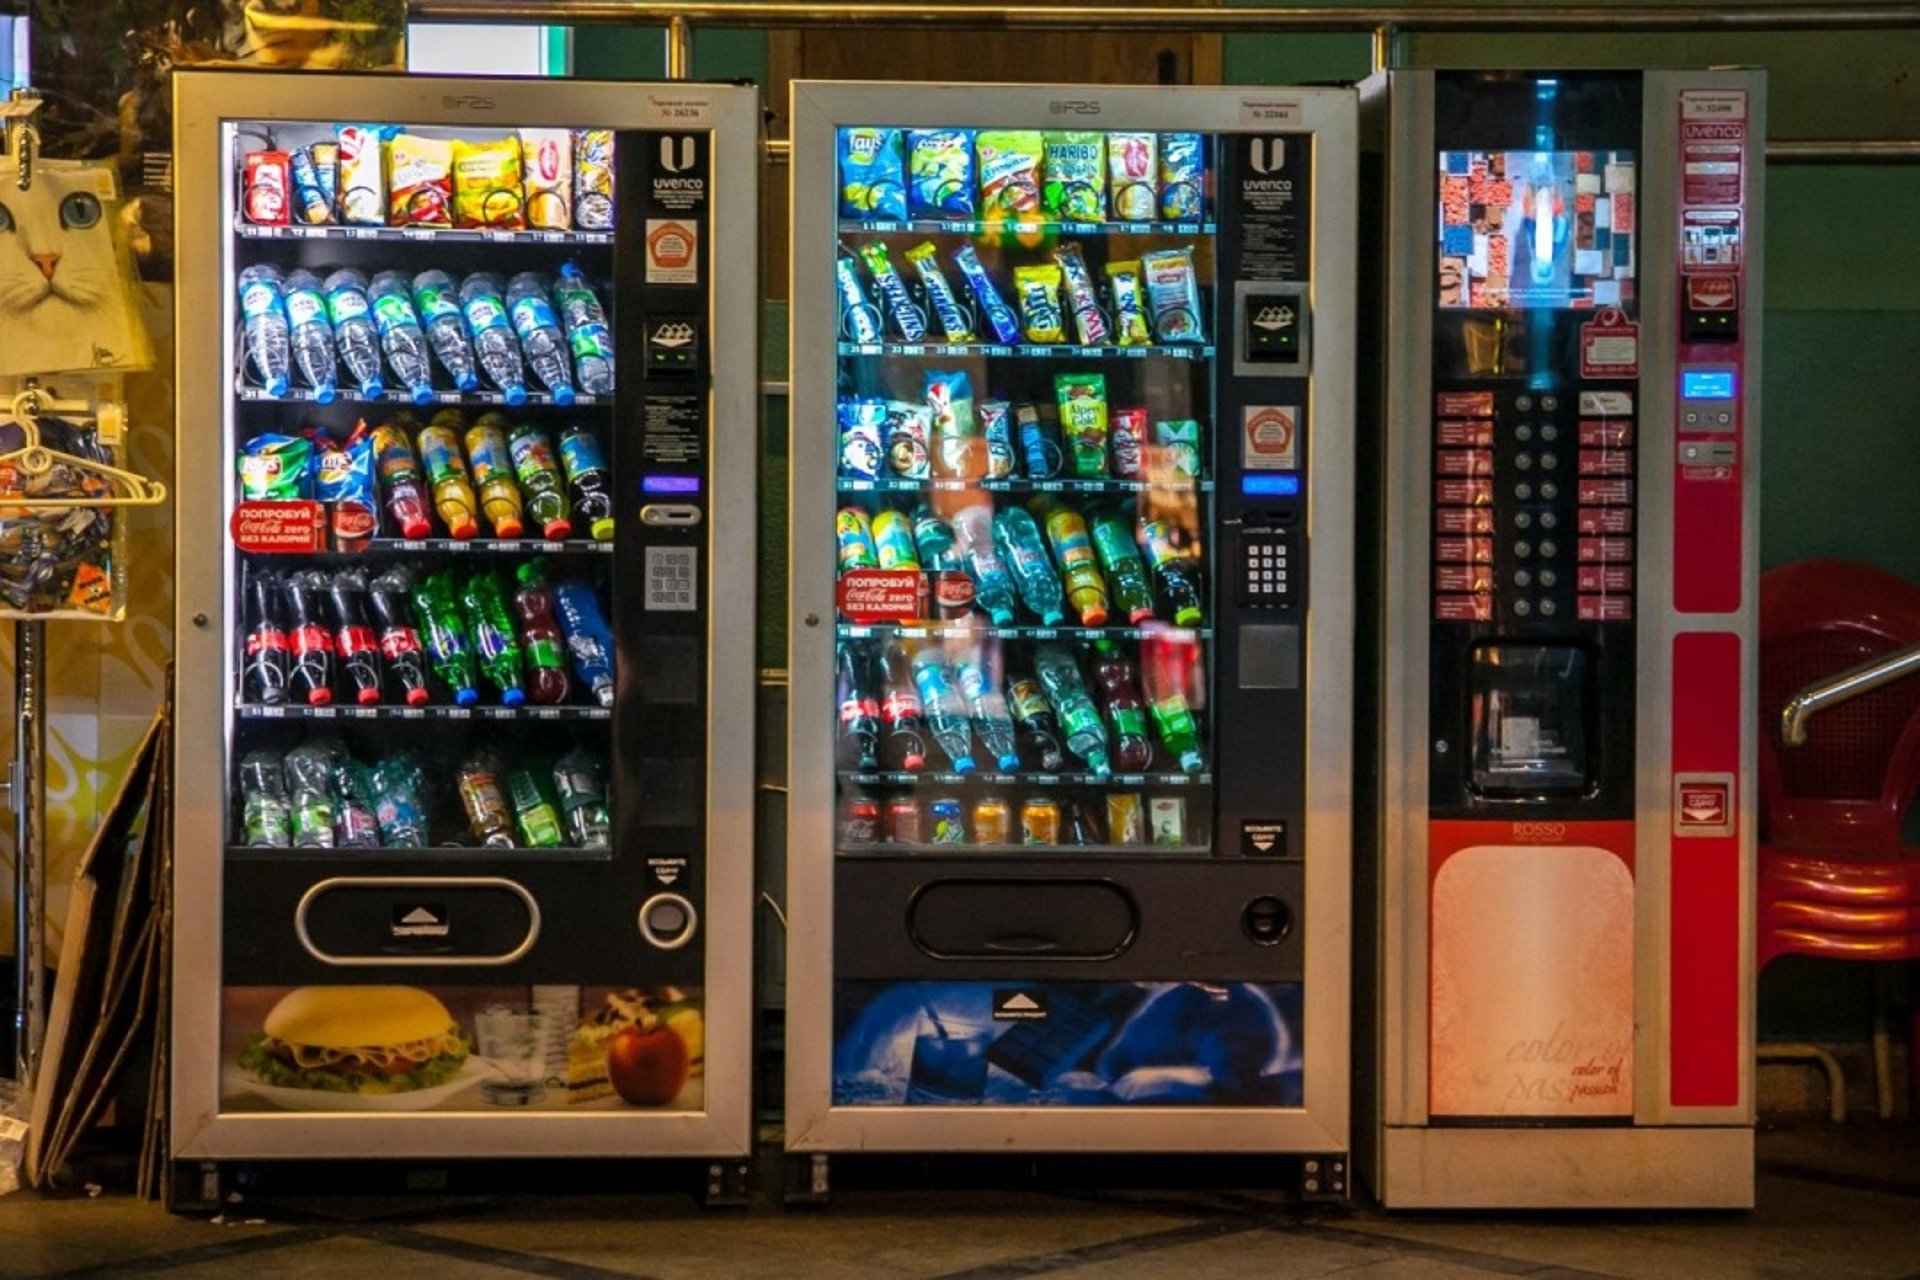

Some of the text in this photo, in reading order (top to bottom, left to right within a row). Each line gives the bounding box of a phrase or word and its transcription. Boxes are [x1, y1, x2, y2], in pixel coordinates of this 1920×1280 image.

[1686, 126, 1741, 138] uvenco
[1049, 145, 1098, 160] HARIBO
[653, 178, 704, 190] uvenco
[1243, 180, 1292, 191] uvenco
[240, 506, 310, 519] ПОПРОБУЙ
[284, 525, 311, 534] zero
[240, 534, 311, 543] БЕЗ КАЛОРИЙ
[846, 575, 915, 588] ПОПРОБУЙ
[889, 594, 915, 603] zero
[846, 602, 915, 611] БЕЗ КАЛОРИЙ
[1512, 822, 1566, 837] ROSSO
[1571, 1056, 1624, 1084] color of
[1568, 1084, 1619, 1104] passion
